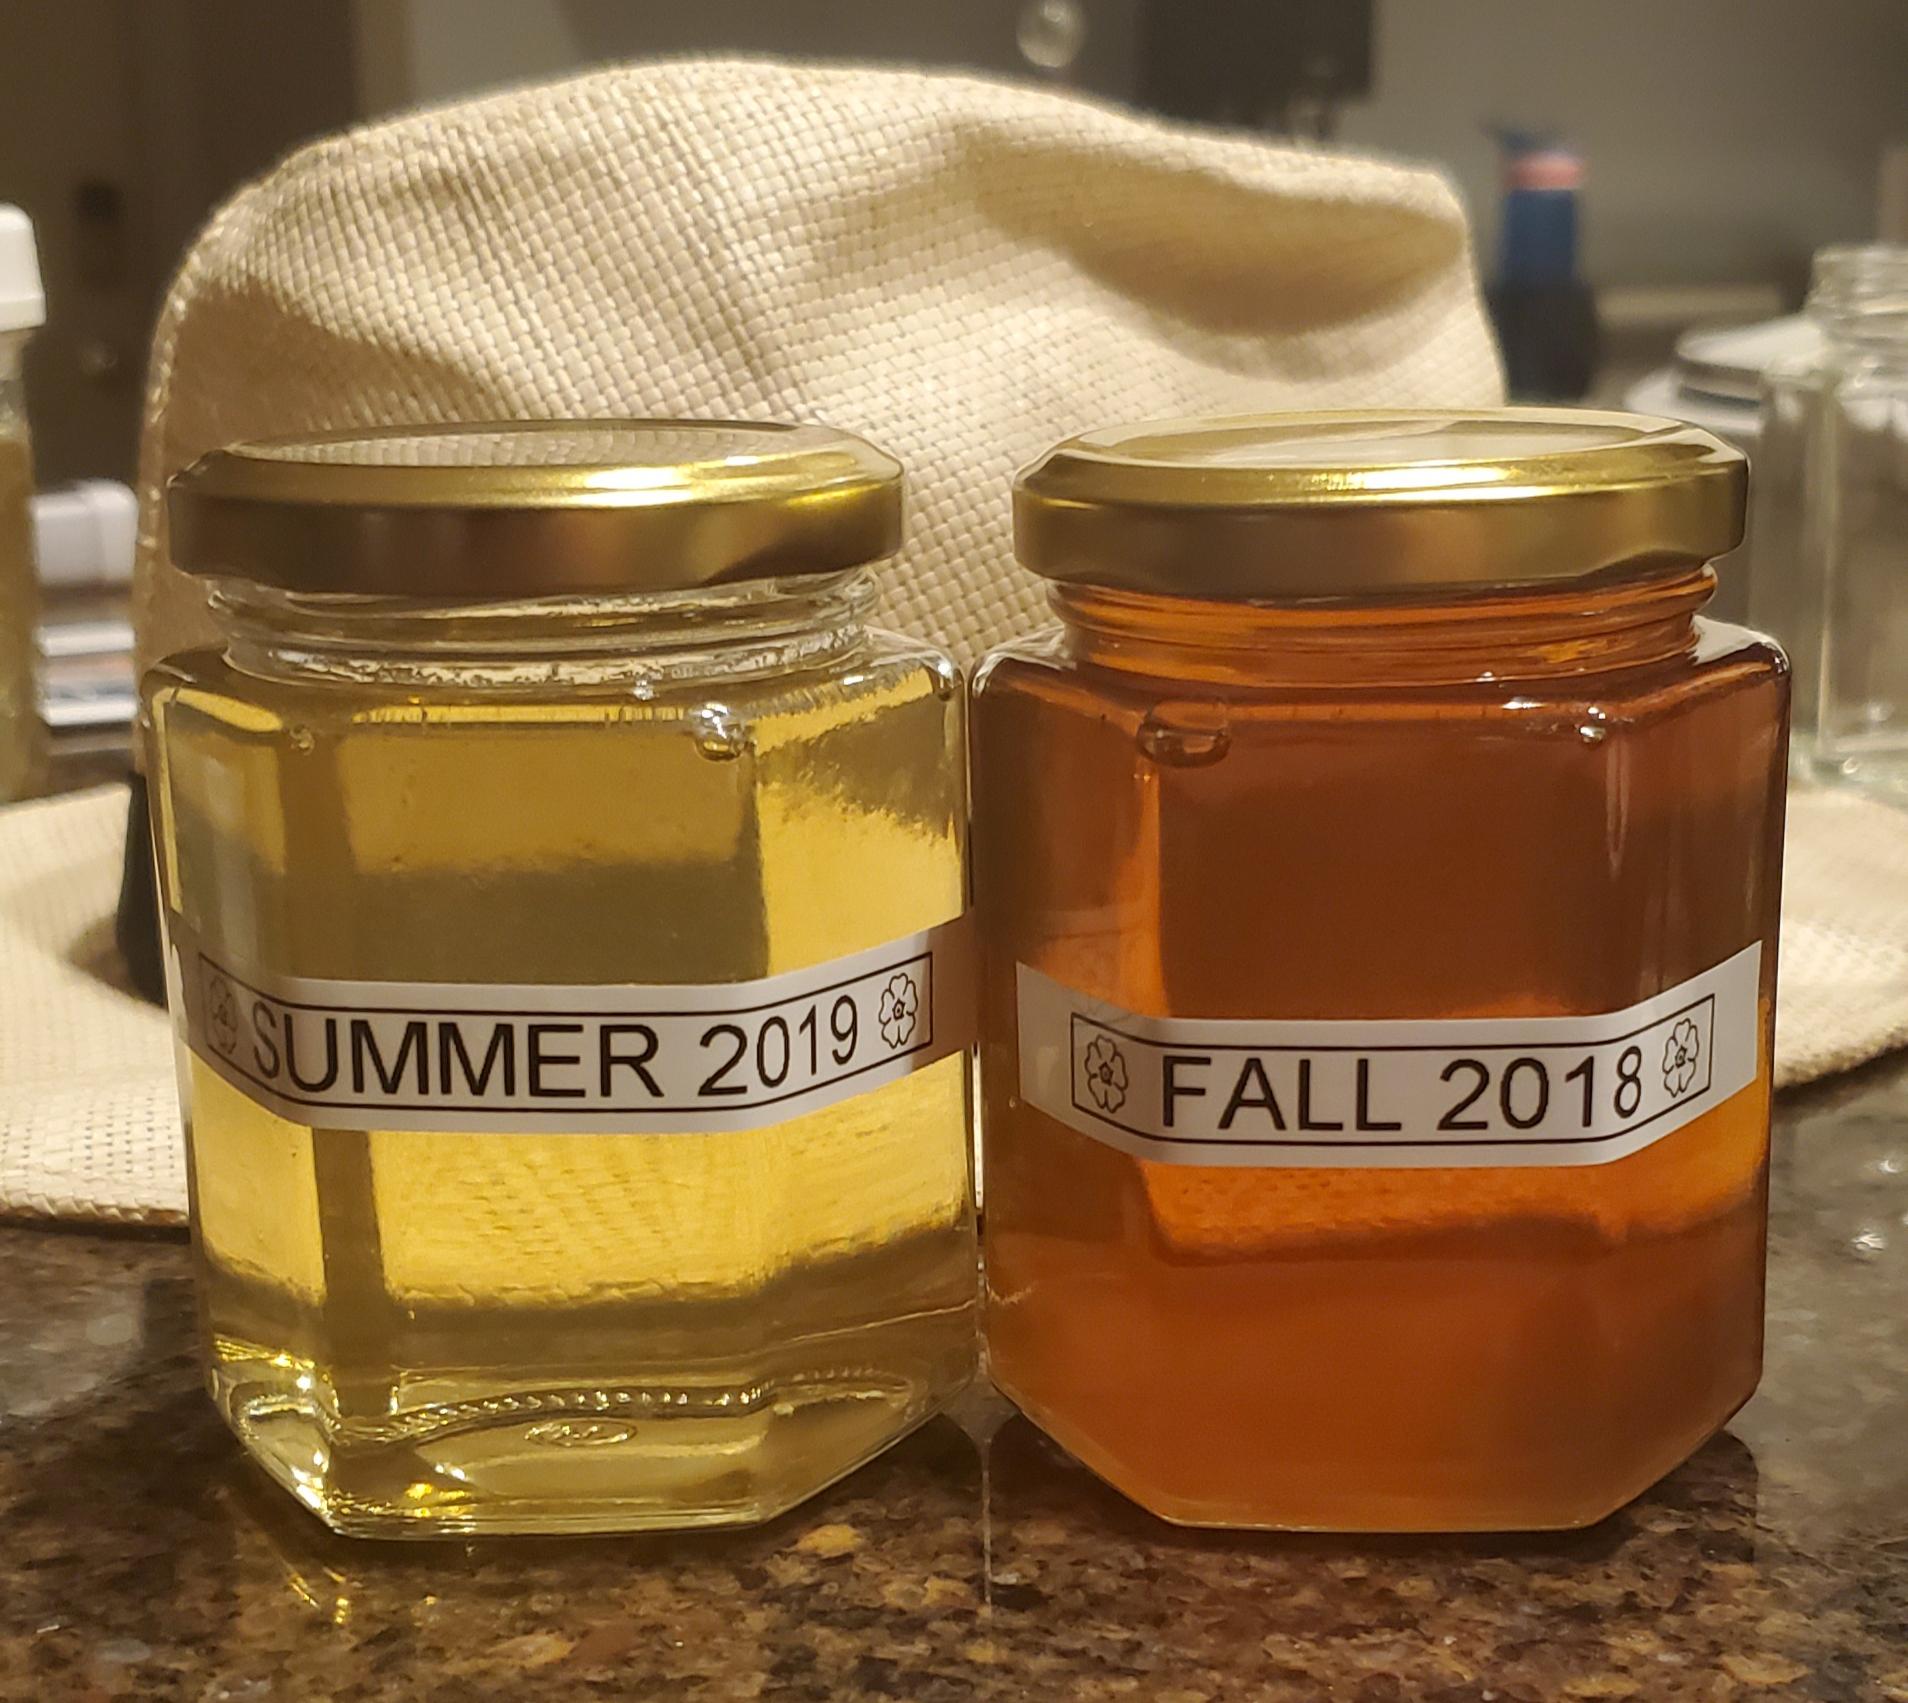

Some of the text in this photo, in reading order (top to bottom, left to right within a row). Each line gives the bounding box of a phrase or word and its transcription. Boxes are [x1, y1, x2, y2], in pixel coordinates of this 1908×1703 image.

[250, 995, 859, 1098] SUMMER 2019
[1161, 1046, 1642, 1131] FALL 2018
